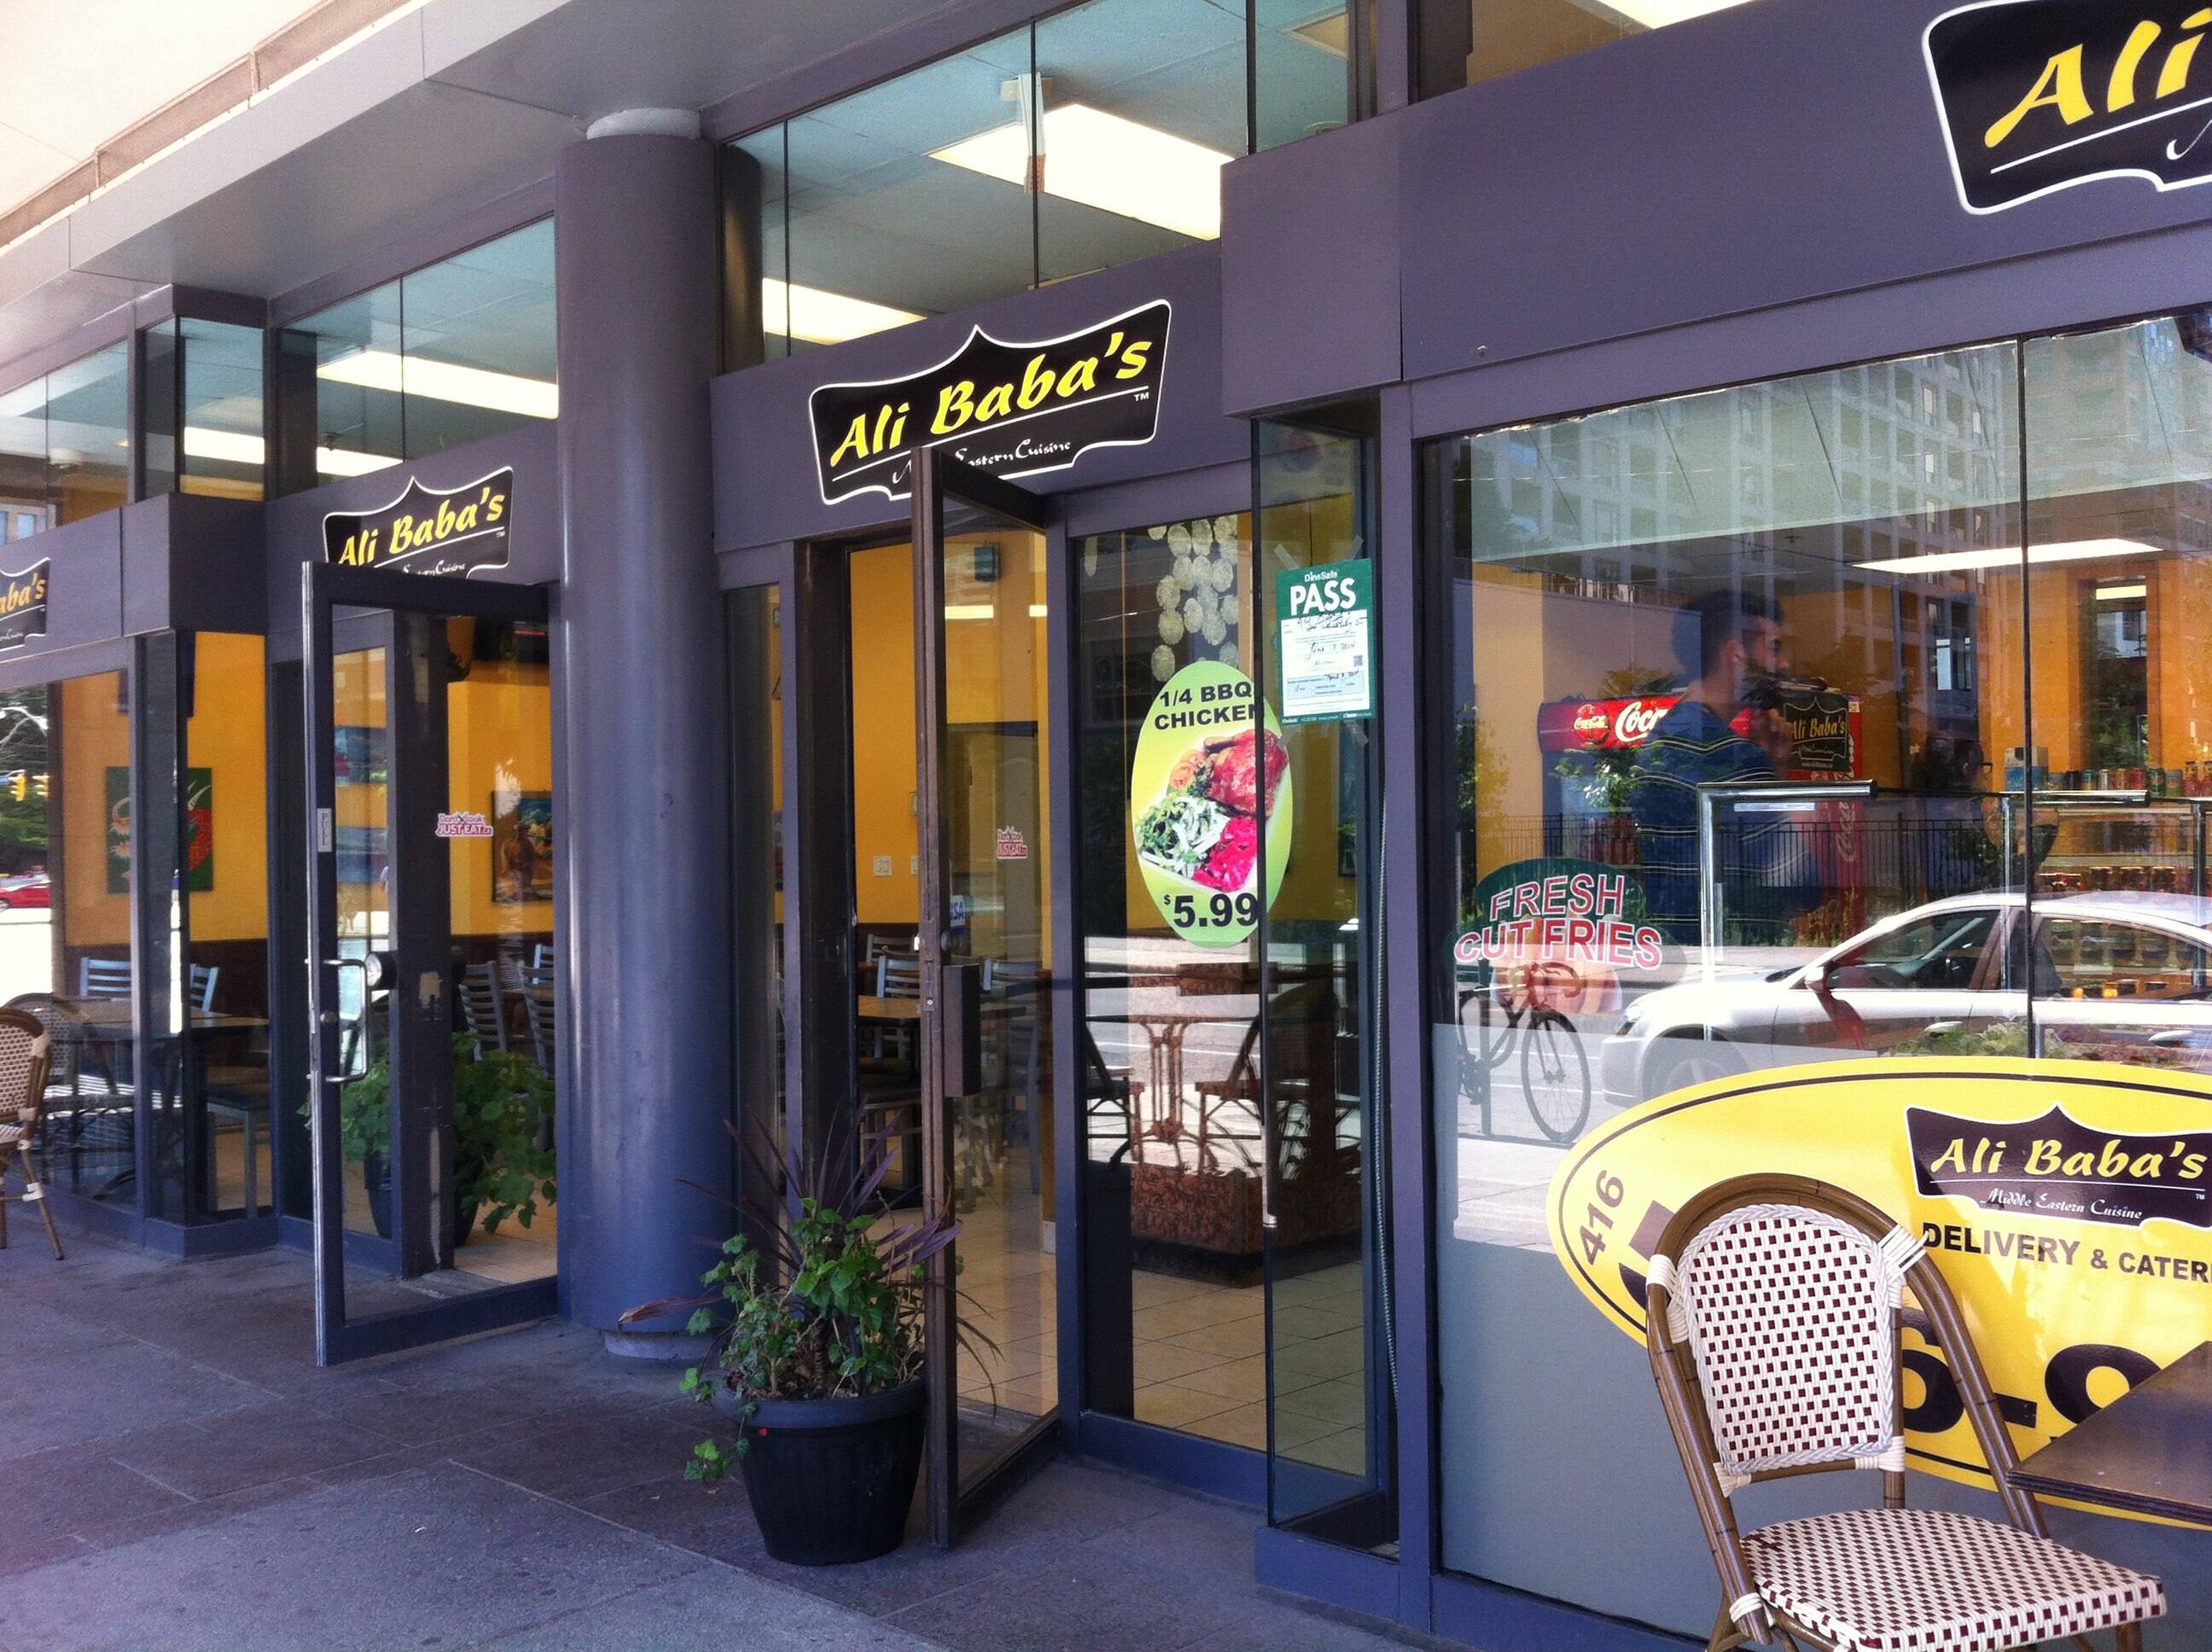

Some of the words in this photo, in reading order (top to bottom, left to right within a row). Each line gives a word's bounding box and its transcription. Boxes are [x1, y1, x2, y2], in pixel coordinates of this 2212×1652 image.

[1984, 8, 2212, 148] Ali
[830, 402, 911, 467] Ali
[930, 331, 1153, 434] Baba's
[1016, 438, 1072, 459] Cuisine
[339, 529, 378, 566] Ali
[389, 486, 505, 554] Baba's
[1289, 577, 1357, 616] PASS
[1304, 570, 1339, 583] DineSafe
[1160, 688, 1193, 707] 1/4
[1201, 681, 1253, 702] BBQ
[1809, 715, 1846, 738] Baba's
[1489, 874, 1625, 922] FRESH
[1453, 919, 1534, 963] CUT
[1541, 917, 1662, 970] FRIES
[1930, 1137, 2007, 1174] Ali
[2023, 1138, 2208, 1179] Baba's
[1579, 1169, 1624, 1265] 416
[1980, 1187, 2032, 1208] Middle
[2035, 1192, 2085, 1213] Eastern
[2090, 1199, 2143, 1219] Cuisine
[1922, 1221, 2081, 1265] DELIVERY
[2090, 1248, 2109, 1270] &
[2119, 1252, 2212, 1283] CATER
